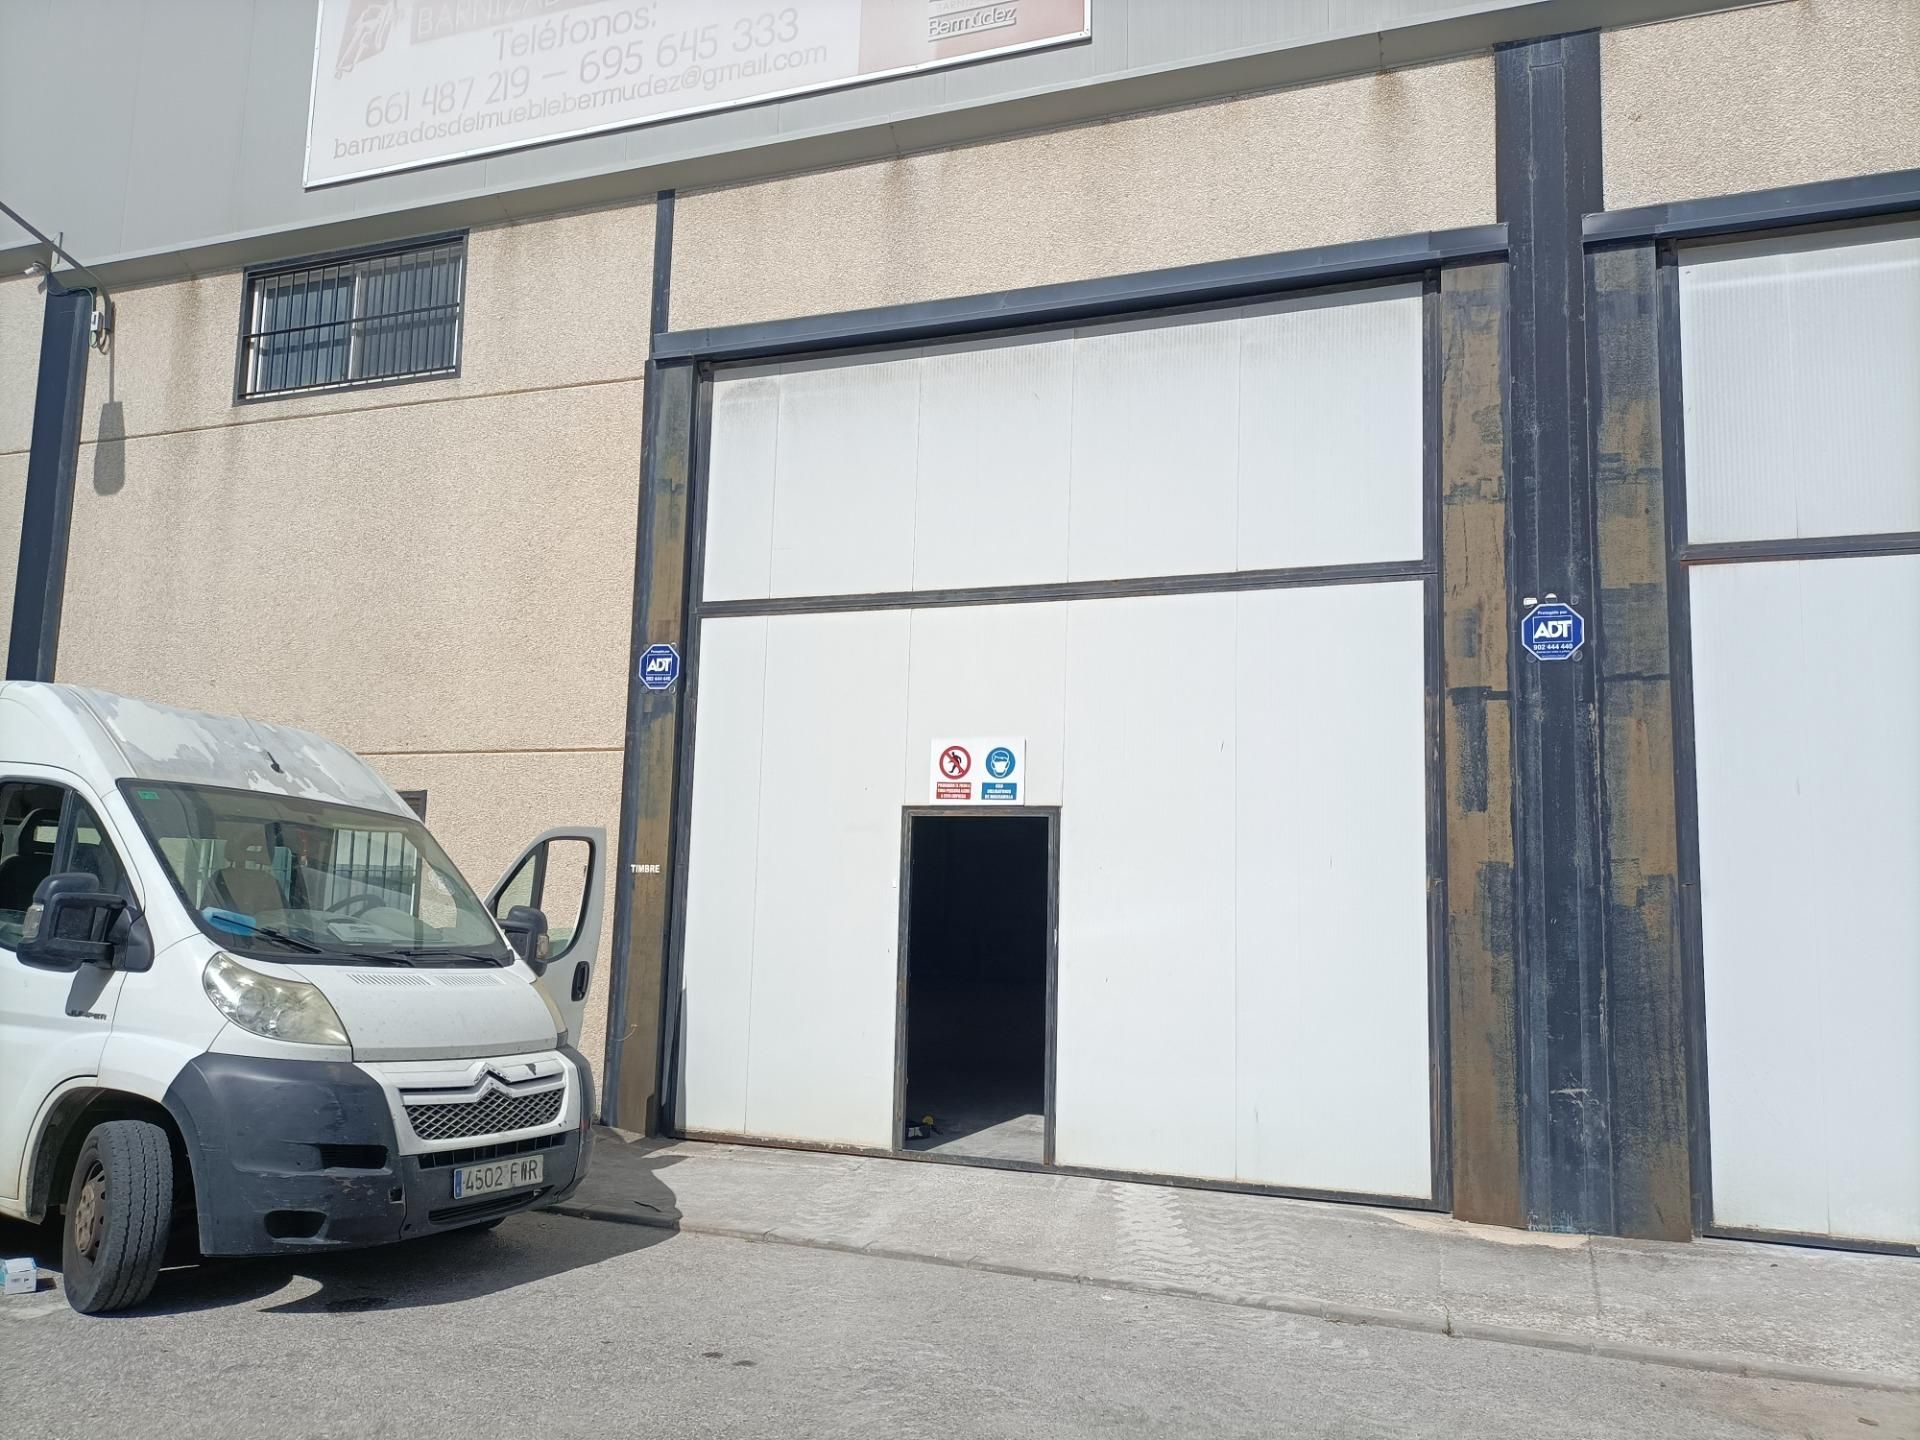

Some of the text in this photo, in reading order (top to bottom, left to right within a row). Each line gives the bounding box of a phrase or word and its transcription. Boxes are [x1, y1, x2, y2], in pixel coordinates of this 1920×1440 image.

[493, 3, 658, 62] Teléfonos:
[928, 7, 1017, 36] Bermúdez
[365, 91, 410, 128] 661
[421, 77, 475, 116] 487
[483, 65, 530, 106] 219
[579, 40, 643, 84] 695
[656, 21, 722, 68] 645
[732, 8, 800, 53] 333
[333, 43, 828, 160] barnizadosdelmueblebermudez@gmail.com
[1533, 620, 1573, 639] ADT
[647, 657, 672, 672] ADT
[630, 864, 660, 873] TIMBRE
[465, 1165, 503, 1191] 4502
